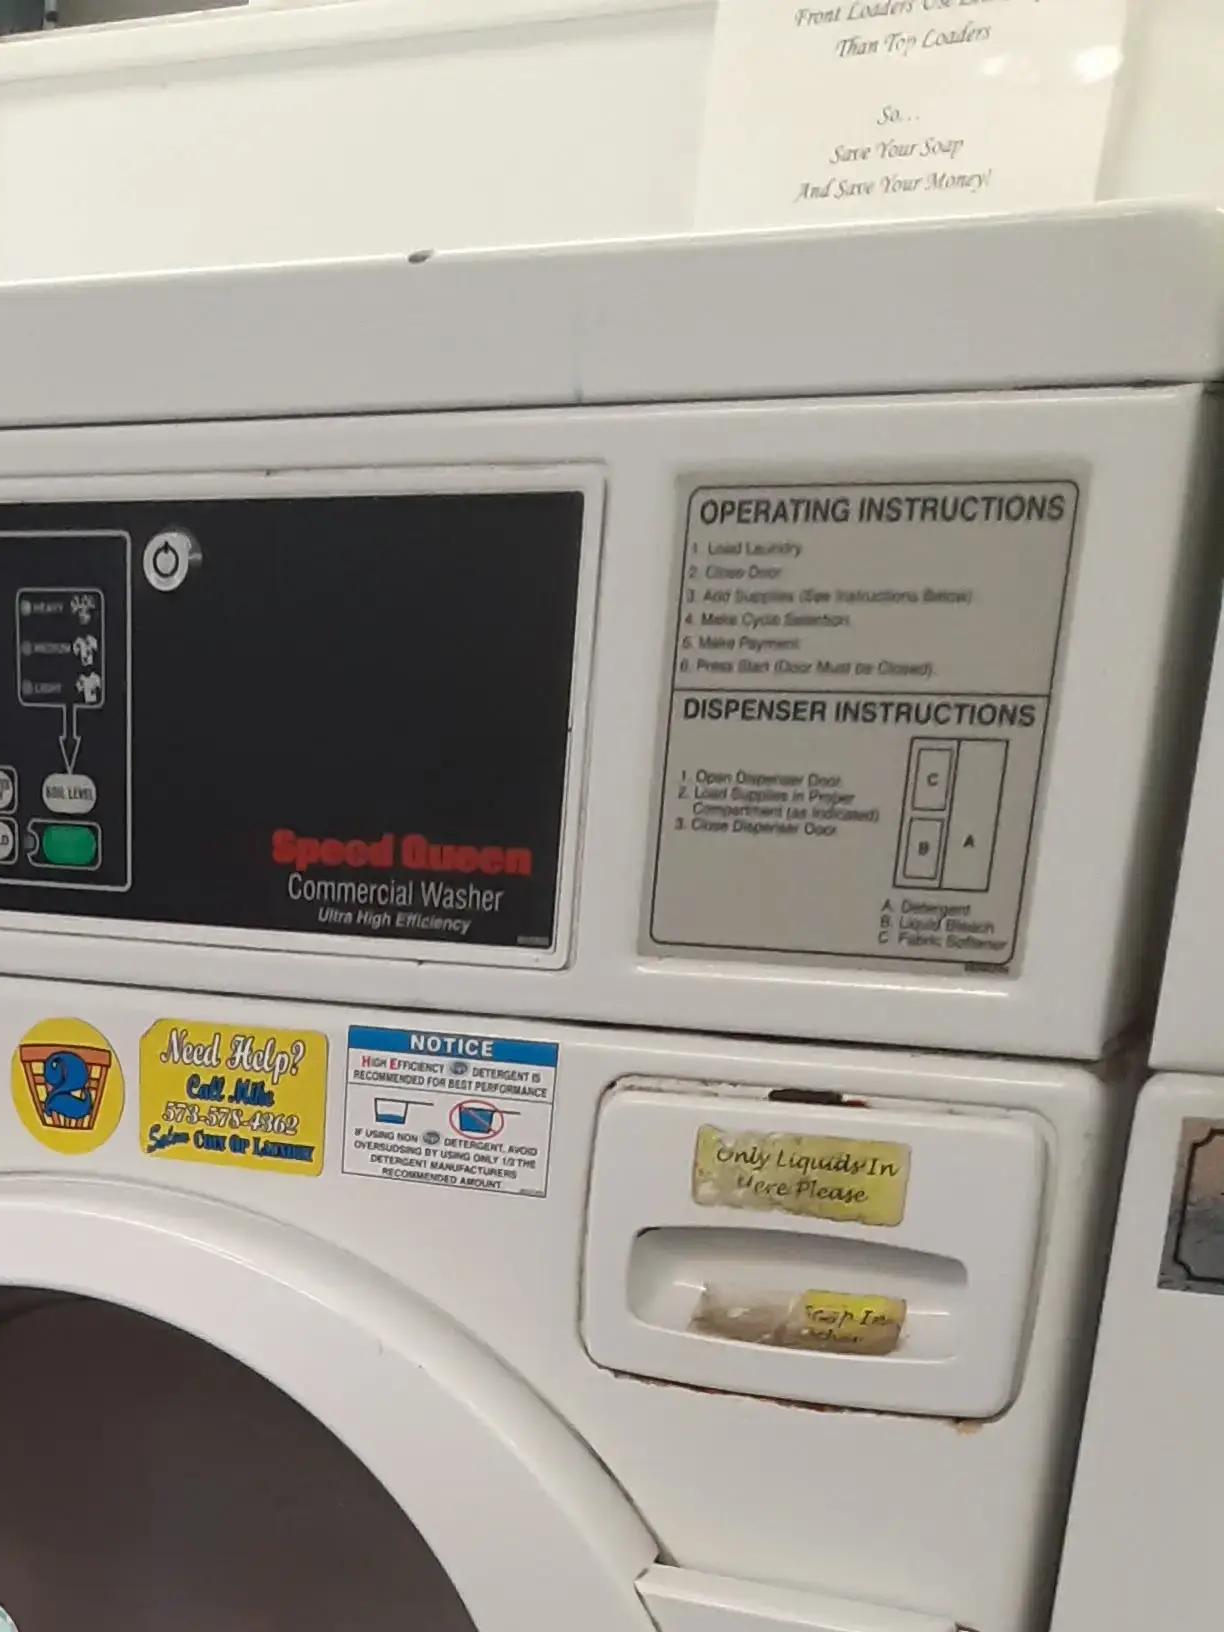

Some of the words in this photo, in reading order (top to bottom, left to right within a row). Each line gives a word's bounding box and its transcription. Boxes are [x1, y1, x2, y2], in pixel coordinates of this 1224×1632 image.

[794, 8, 840, 27] Front
[847, 0, 913, 22] Loaders
[836, 36, 878, 58] Than
[884, 32, 916, 56] Top
[922, 21, 991, 49] Loaders
[829, 145, 871, 164] Save
[877, 139, 918, 159] Your
[920, 137, 964, 160] Soap
[792, 177, 836, 203] And
[834, 179, 875, 200] Save
[880, 174, 923, 194] Your
[701, 497, 851, 525] OPERATING
[859, 495, 1065, 523] INSTRUCTIONS
[33, 602, 64, 613] HEAVY
[684, 699, 827, 723] DISPENSER
[834, 702, 1037, 729] INSTRUCTIONS
[927, 773, 939, 786] C
[67, 787, 94, 800] LEVEL
[271, 827, 394, 872] Speed
[400, 833, 533, 876] Queen
[918, 842, 930, 856] B
[963, 835, 975, 848] A
[288, 872, 413, 907] Commercial
[420, 880, 505, 912] Washer
[317, 906, 353, 925] Ultra
[356, 909, 391, 930] High
[395, 911, 473, 935] Efficiency
[160, 1028, 222, 1069] Need
[226, 1034, 306, 1086] Help?
[410, 1034, 495, 1058] NOTICE
[361, 1055, 387, 1069] HIGH
[388, 1057, 445, 1074] EFFICIENCY
[472, 1067, 530, 1083] DETERGENT
[532, 1072, 542, 1083] IS
[186, 1074, 226, 1102] Call
[353, 1069, 425, 1086] RECOMMENDED
[427, 1077, 446, 1088] FOR
[448, 1078, 473, 1090] BEST
[475, 1081, 548, 1098] PERFORMANCE
[365, 1130, 394, 1141] USING
[397, 1132, 418, 1143] NON
[508, 1144, 538, 1157] AVOID
[370, 1153, 427, 1169] DETERGENT
[424, 1148, 438, 1158] BY
[440, 1149, 471, 1161] USING
[473, 1153, 500, 1165] ONLY
[518, 1158, 537, 1170] THE
[716, 1145, 771, 1171] Only
[776, 1149, 866, 1176] Liquids
[866, 1157, 901, 1178] In
[382, 1167, 457, 1185] RECOMMENDED
[459, 1177, 503, 1189] AMOUNT
[795, 1179, 869, 1204] Please
